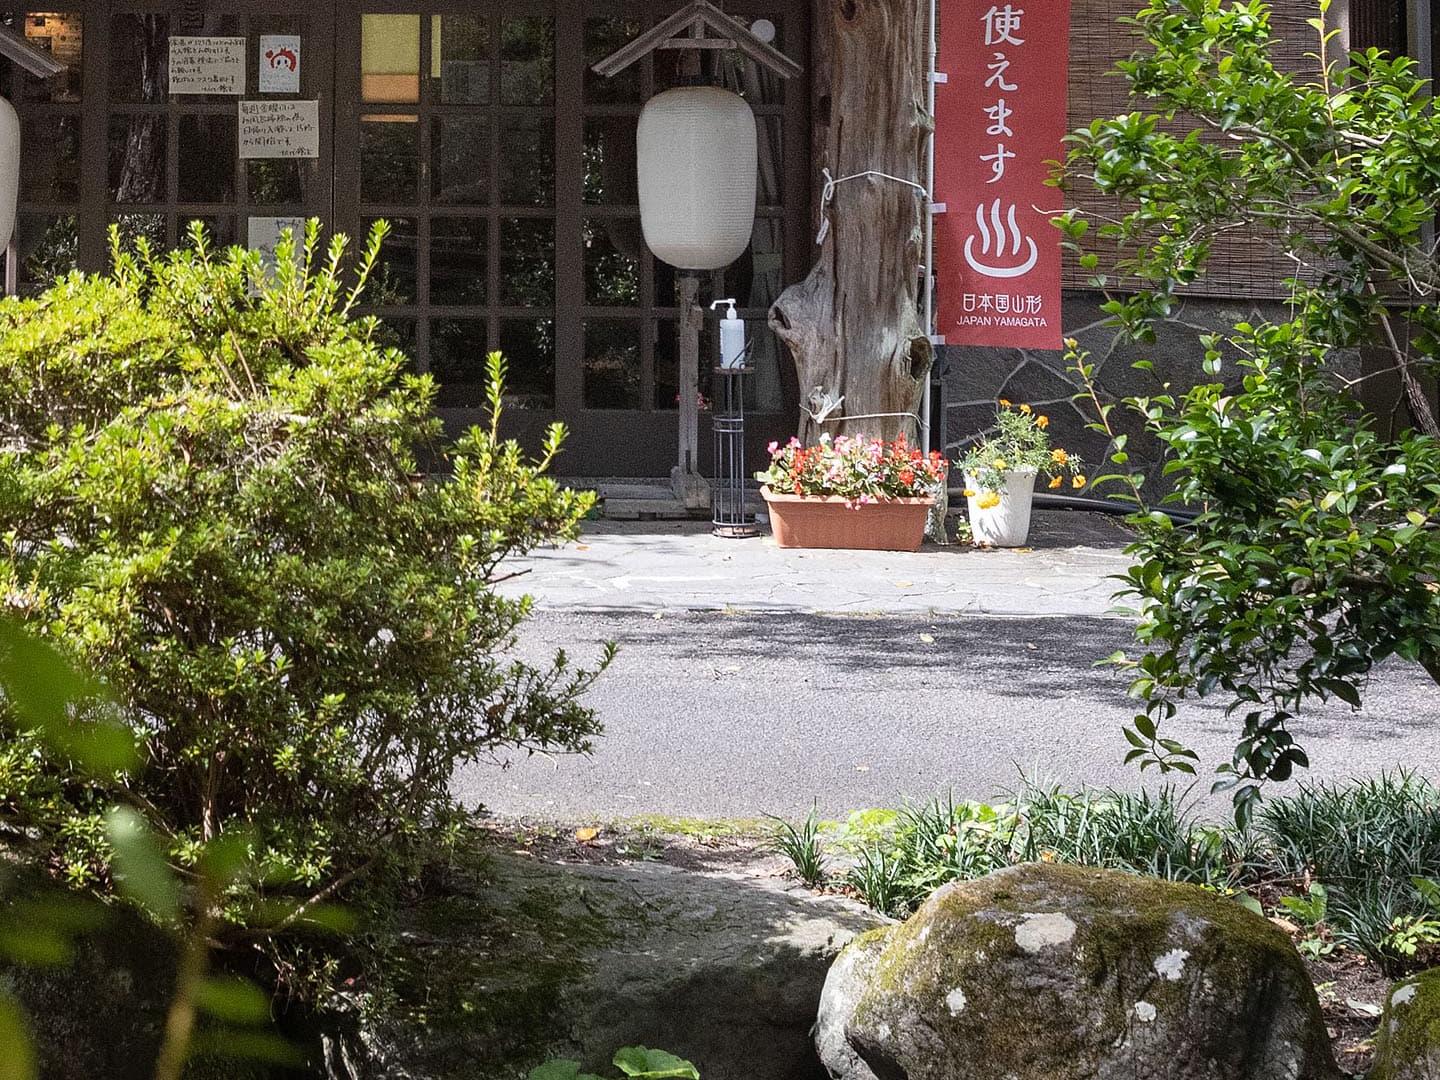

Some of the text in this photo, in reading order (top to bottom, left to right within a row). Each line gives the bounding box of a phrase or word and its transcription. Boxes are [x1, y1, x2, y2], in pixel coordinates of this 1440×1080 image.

[978, 4, 1026, 184] 使えます
[962, 293, 1043, 314] 日本国山形
[956, 315, 1048, 327] JAPAN YAMAGATA
